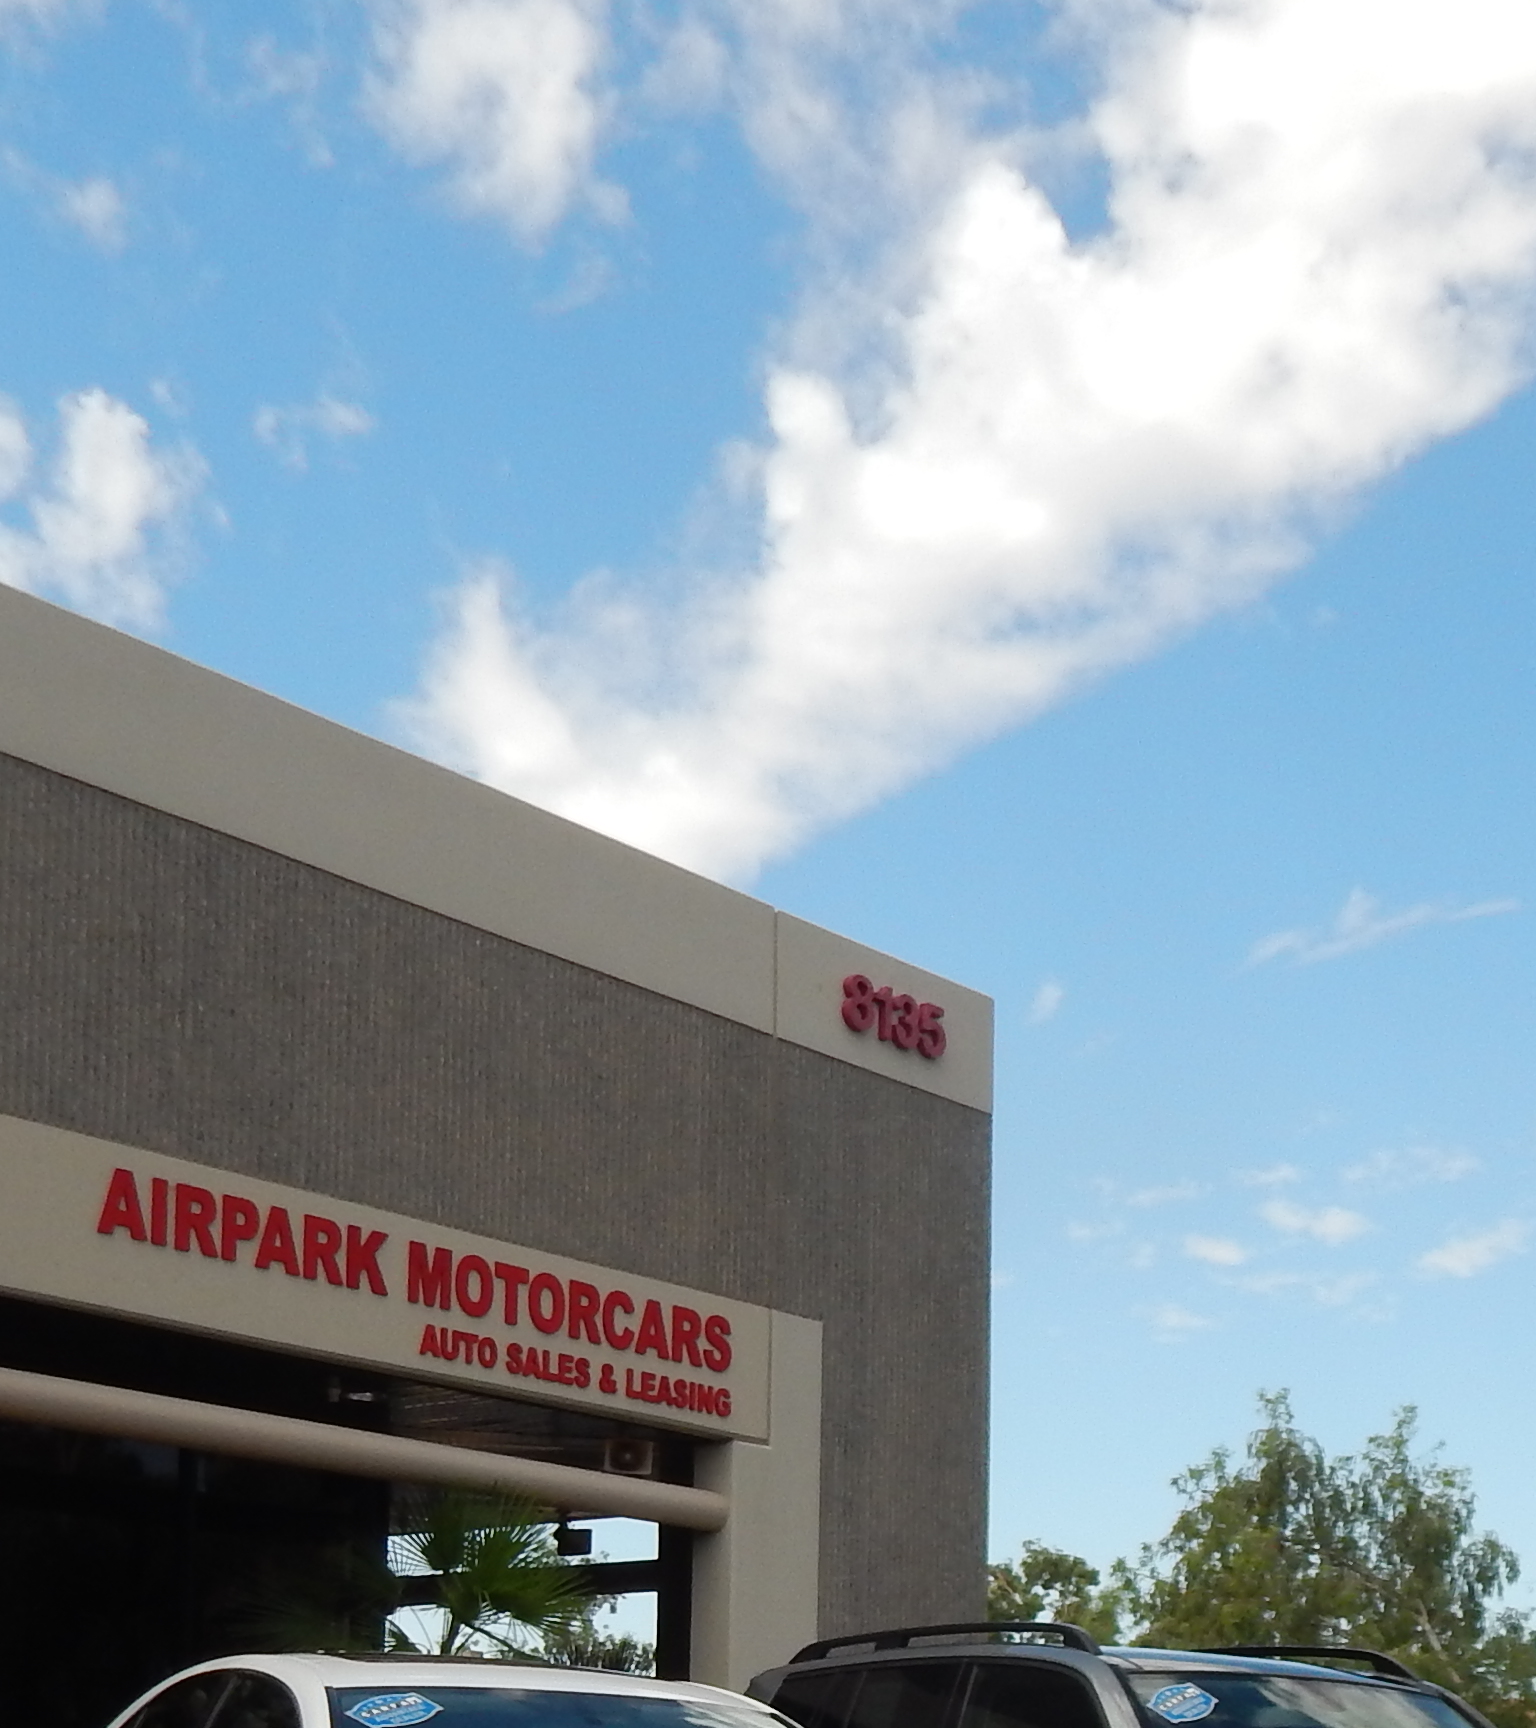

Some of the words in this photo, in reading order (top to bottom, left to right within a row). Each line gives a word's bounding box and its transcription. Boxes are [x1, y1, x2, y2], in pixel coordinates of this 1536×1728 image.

[841, 974, 947, 1059] 8135
[97, 1167, 389, 1296] AIRPARK
[406, 1240, 733, 1372] MOTORCARS
[419, 1324, 498, 1368] AUTO
[505, 1342, 591, 1388] SALES
[598, 1363, 617, 1393] &
[625, 1368, 732, 1417] LEASING
